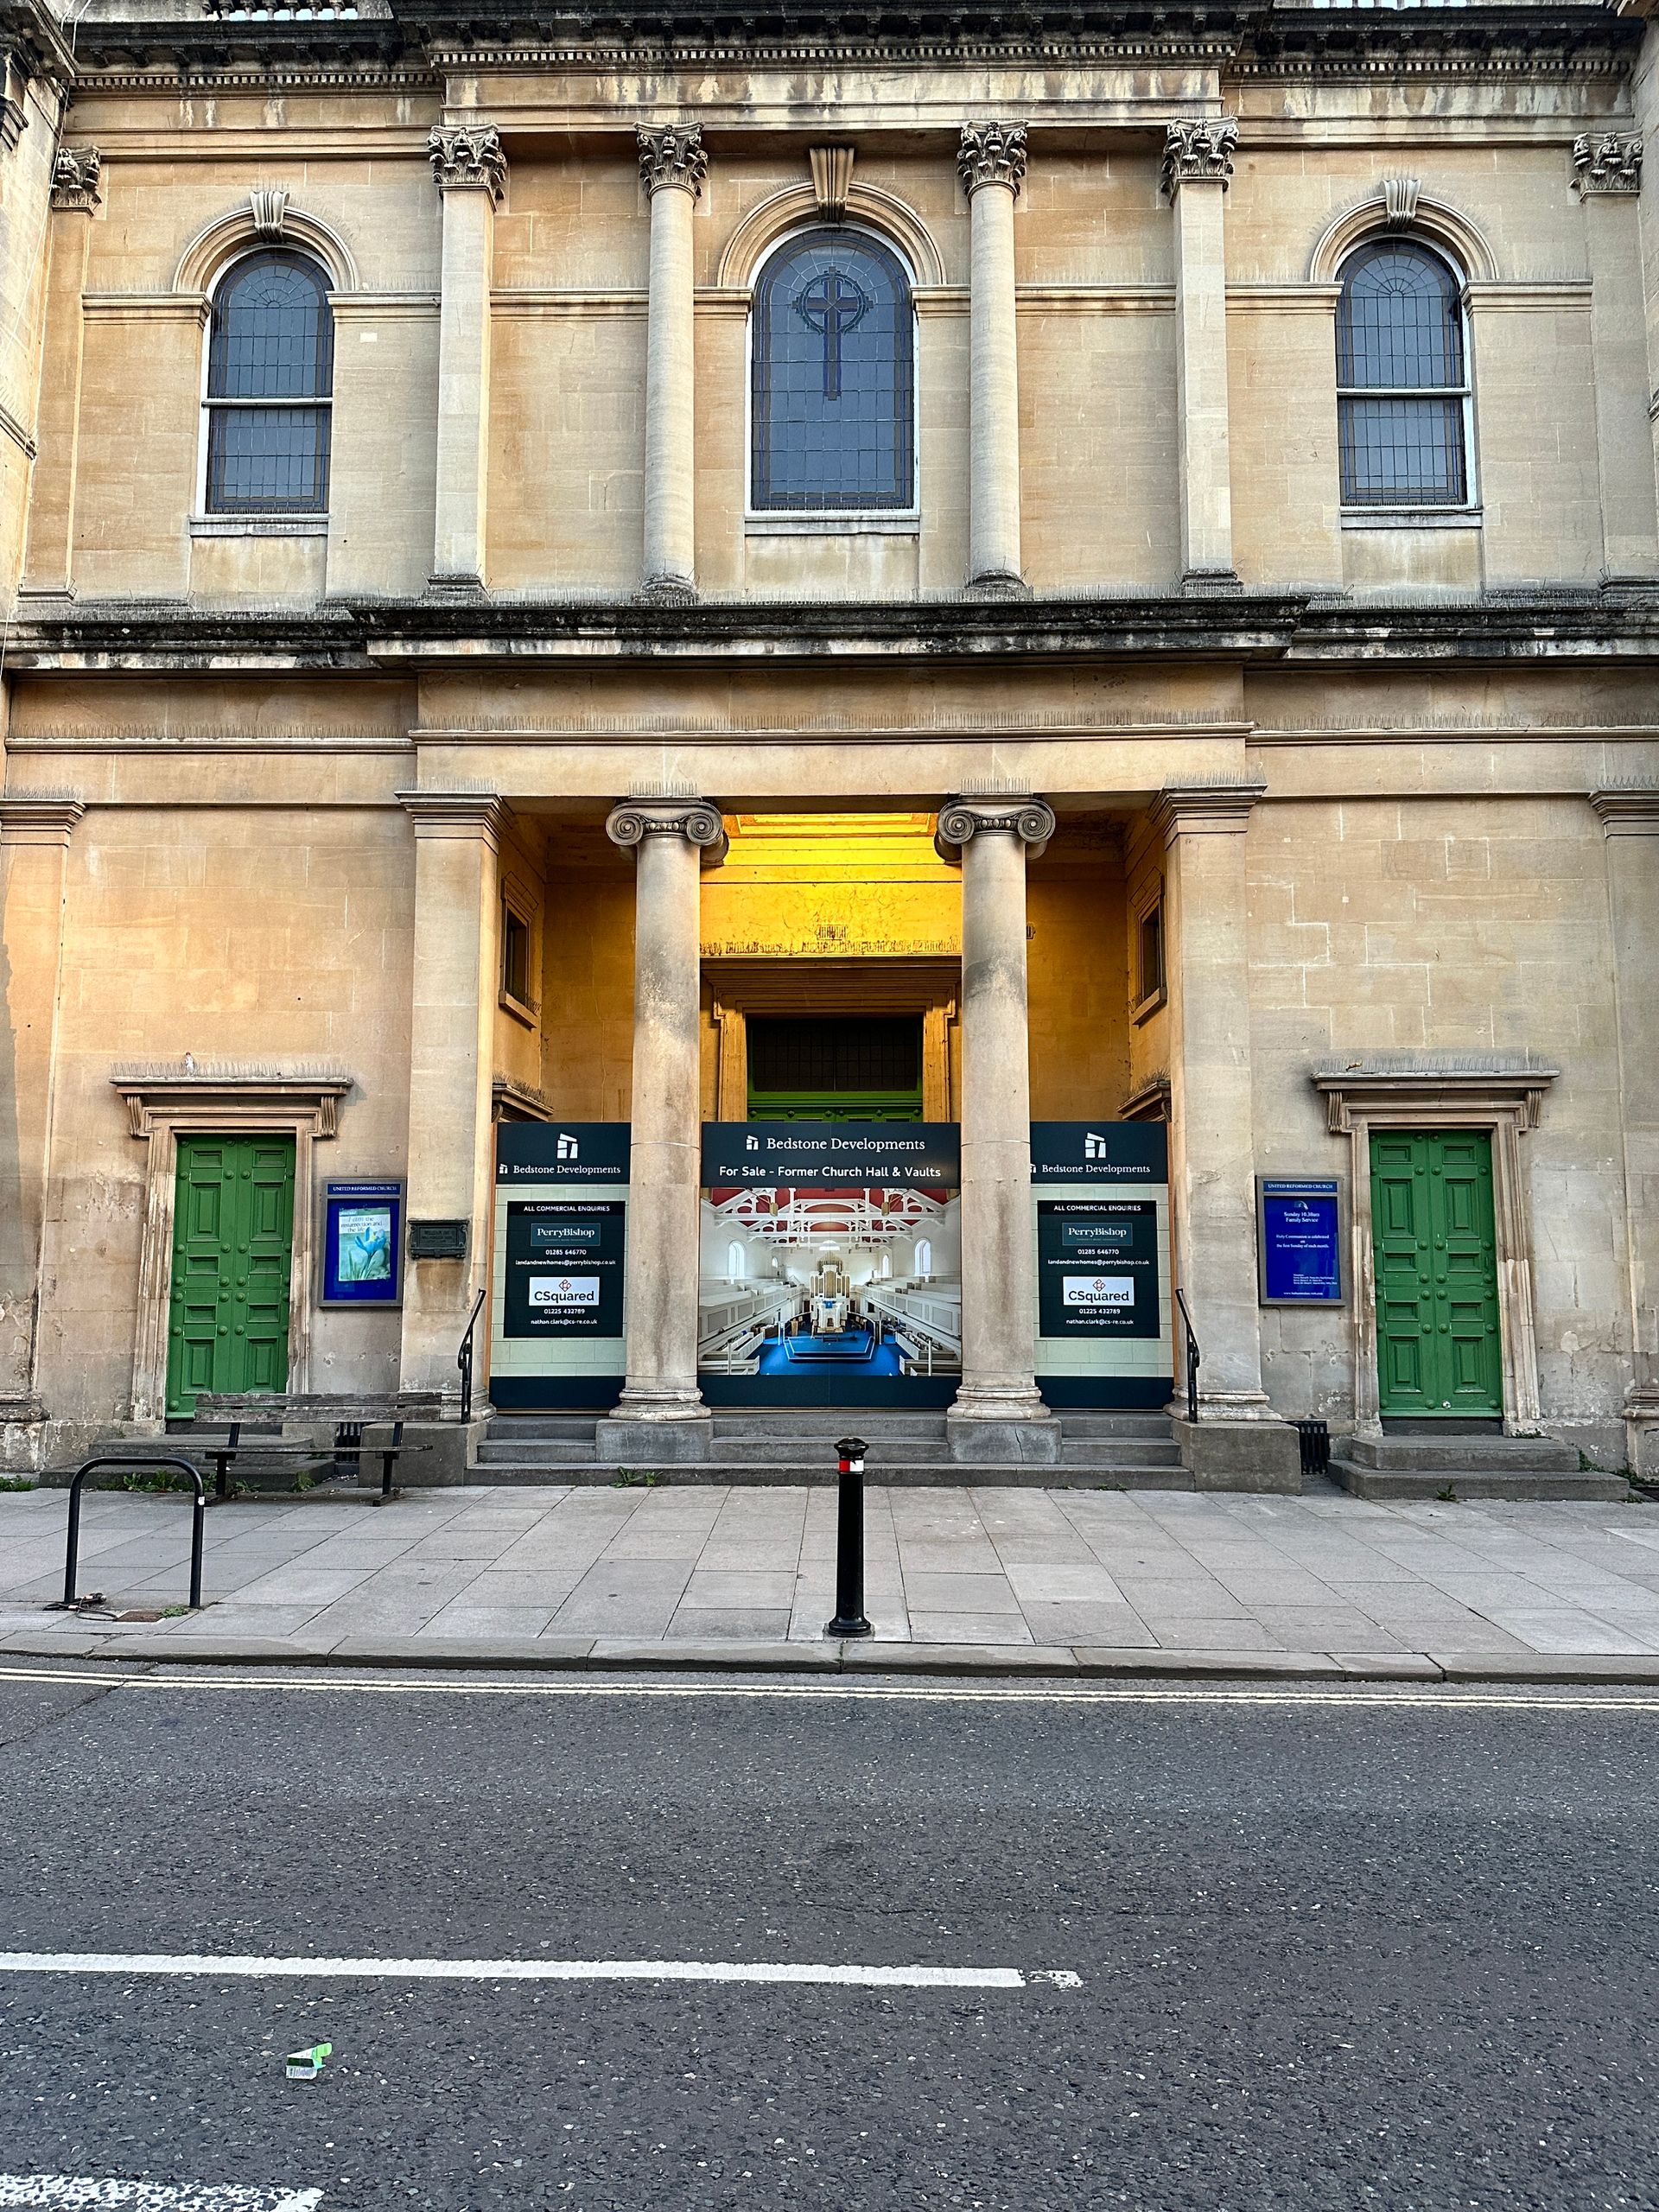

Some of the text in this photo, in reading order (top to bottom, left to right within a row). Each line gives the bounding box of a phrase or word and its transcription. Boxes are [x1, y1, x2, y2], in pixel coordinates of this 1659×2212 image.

[766, 1137, 926, 1153] Bedstone Developments
[512, 1165, 621, 1176] Bedstone Developments
[719, 1166, 739, 1177] For
[741, 1166, 766, 1177] Sale
[778, 1166, 819, 1177] Former
[822, 1166, 862, 1177] Church
[865, 1166, 889, 1177] Hall
[892, 1166, 901, 1177] &
[904, 1166, 942, 1177] Vaults
[1042, 1164, 1151, 1175] Bedstone Developments
[537, 1227, 595, 1237] PerryBishop
[1068, 1227, 1127, 1237] PerryBishop
[534, 1291, 594, 1303] CSquared
[1068, 1290, 1129, 1303] CSquared
